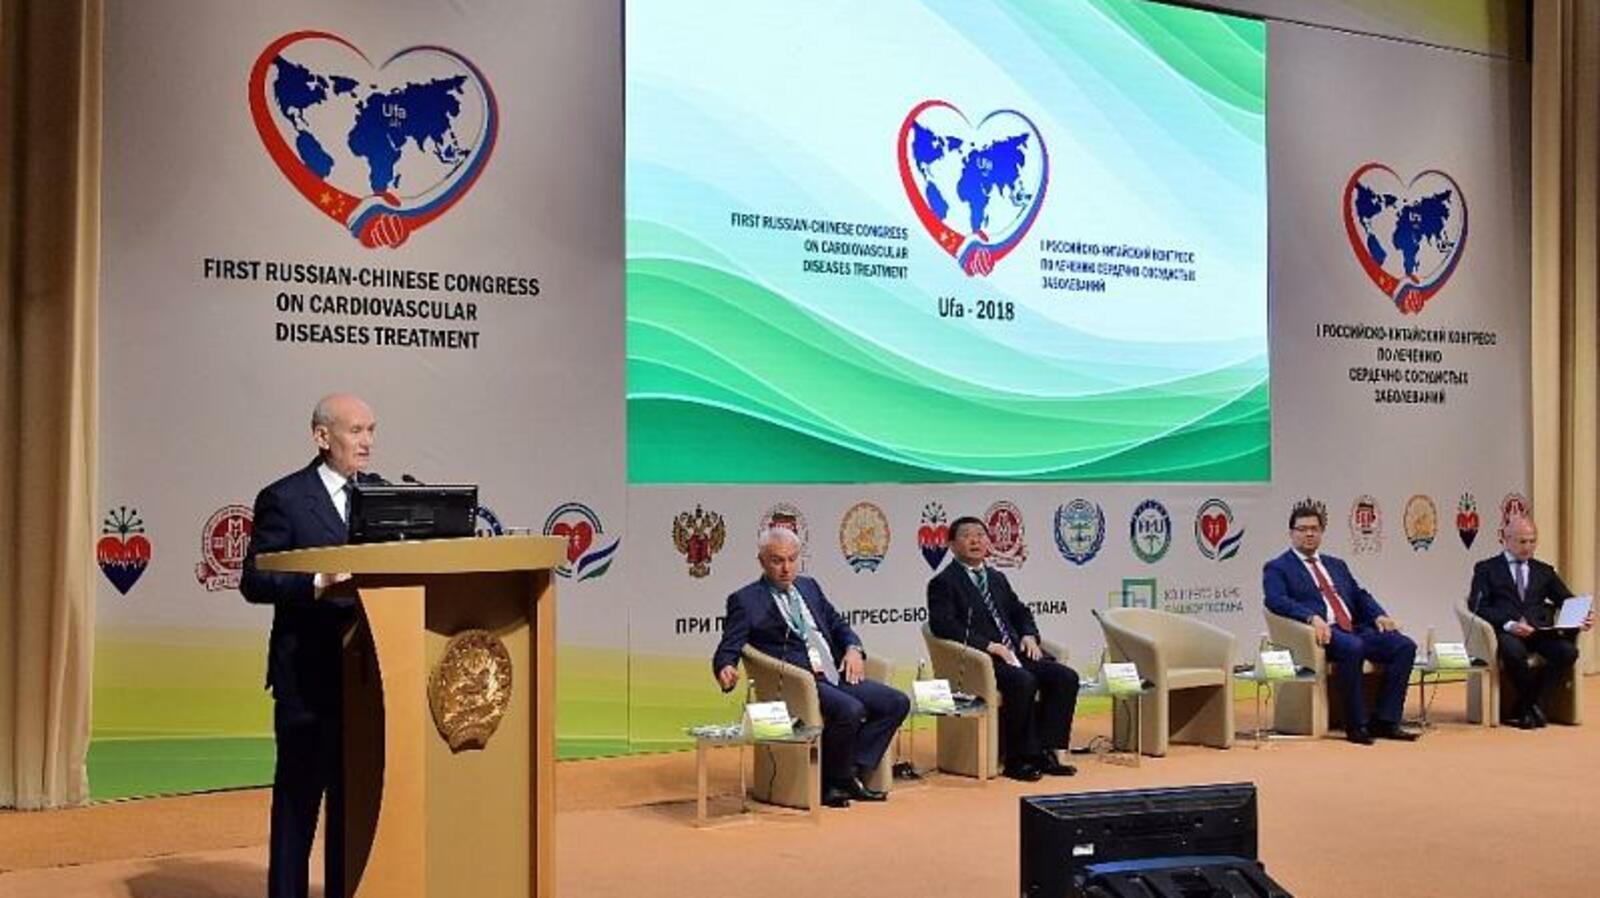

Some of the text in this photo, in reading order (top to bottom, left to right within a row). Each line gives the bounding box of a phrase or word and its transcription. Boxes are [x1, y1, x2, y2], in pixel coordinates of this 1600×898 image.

[382, 103, 406, 120] Ufa
[731, 212, 908, 241] FIRST RUSSIAN-CHINESE CONGRESS
[804, 239, 908, 259] ON CARDIOVASCULAR
[803, 260, 908, 279] DISEASES TREATMENT
[1041, 258, 1053, 271] ПО
[203, 258, 540, 296] FIRST RUSSIAN-CHINESE CONGRESS
[276, 293, 478, 320] ON CARDIOVASCULAR
[938, 297, 964, 318] Ufa
[976, 300, 1015, 321] 2018
[275, 322, 480, 350] DISEASES TREATMENT
[1322, 324, 1446, 344] РОССИЙСКО-КИТАЙСКИЙ
[1448, 330, 1497, 346] КОНГРЕСС
[1377, 347, 1443, 364] ПО ЛЕЧЕНИЮ
[1375, 388, 1446, 404] ЗАБОЛЕВАНИЙ
[676, 618, 710, 634] ПРИ
[839, 607, 928, 626] НГРЕСС-БЮ
